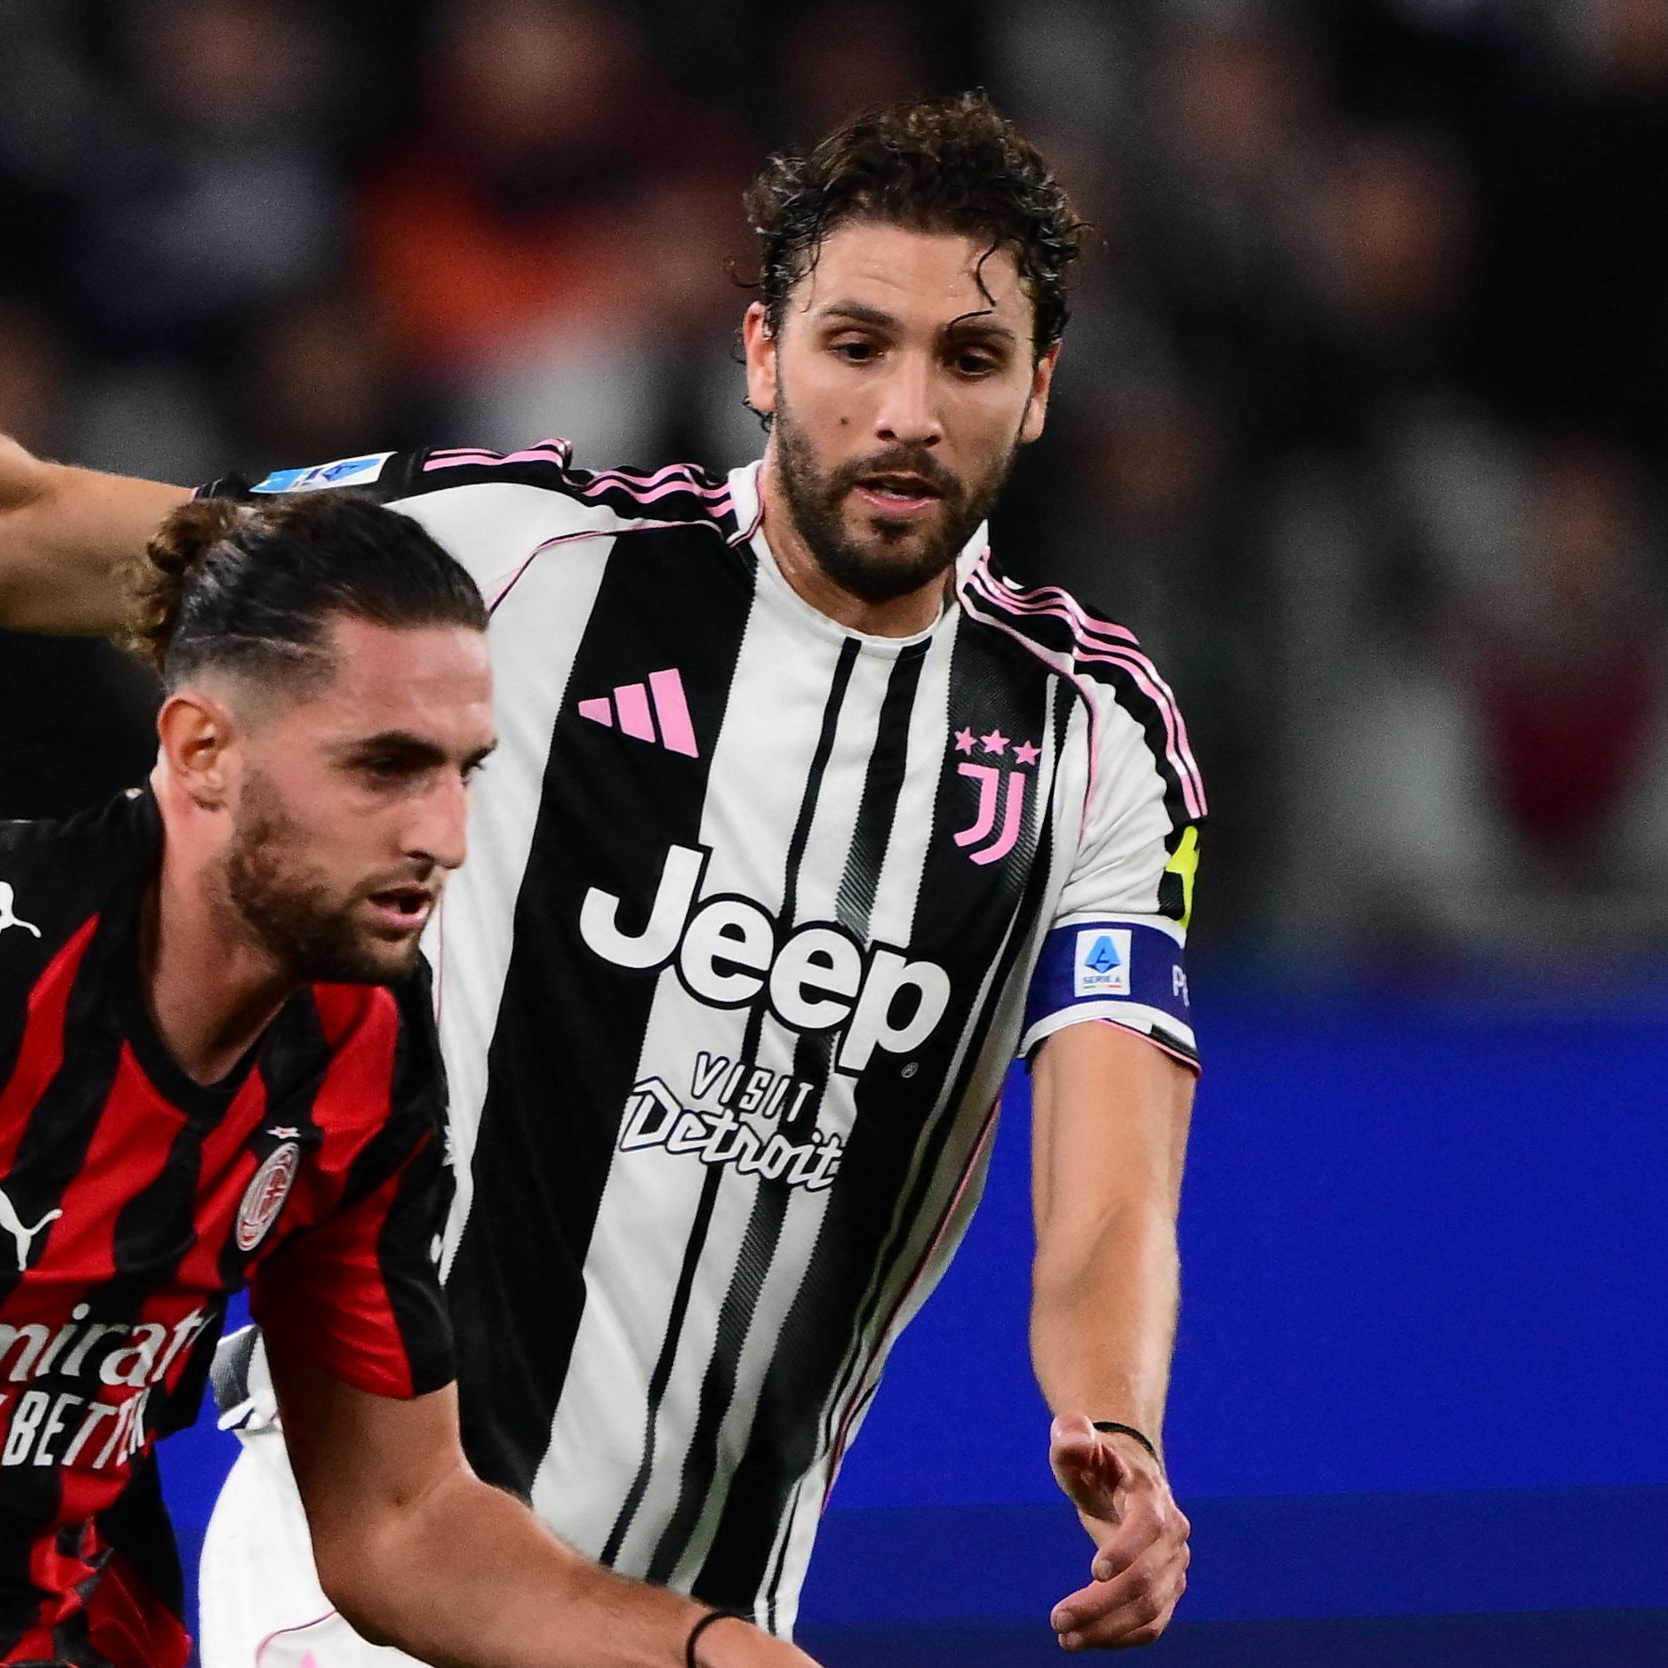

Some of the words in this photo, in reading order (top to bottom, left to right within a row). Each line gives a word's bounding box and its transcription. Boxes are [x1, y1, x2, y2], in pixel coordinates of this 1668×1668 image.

[580, 844, 950, 1070] Jeep
[620, 1077, 843, 1190] Detroit
[692, 1052, 814, 1122] VISIT
